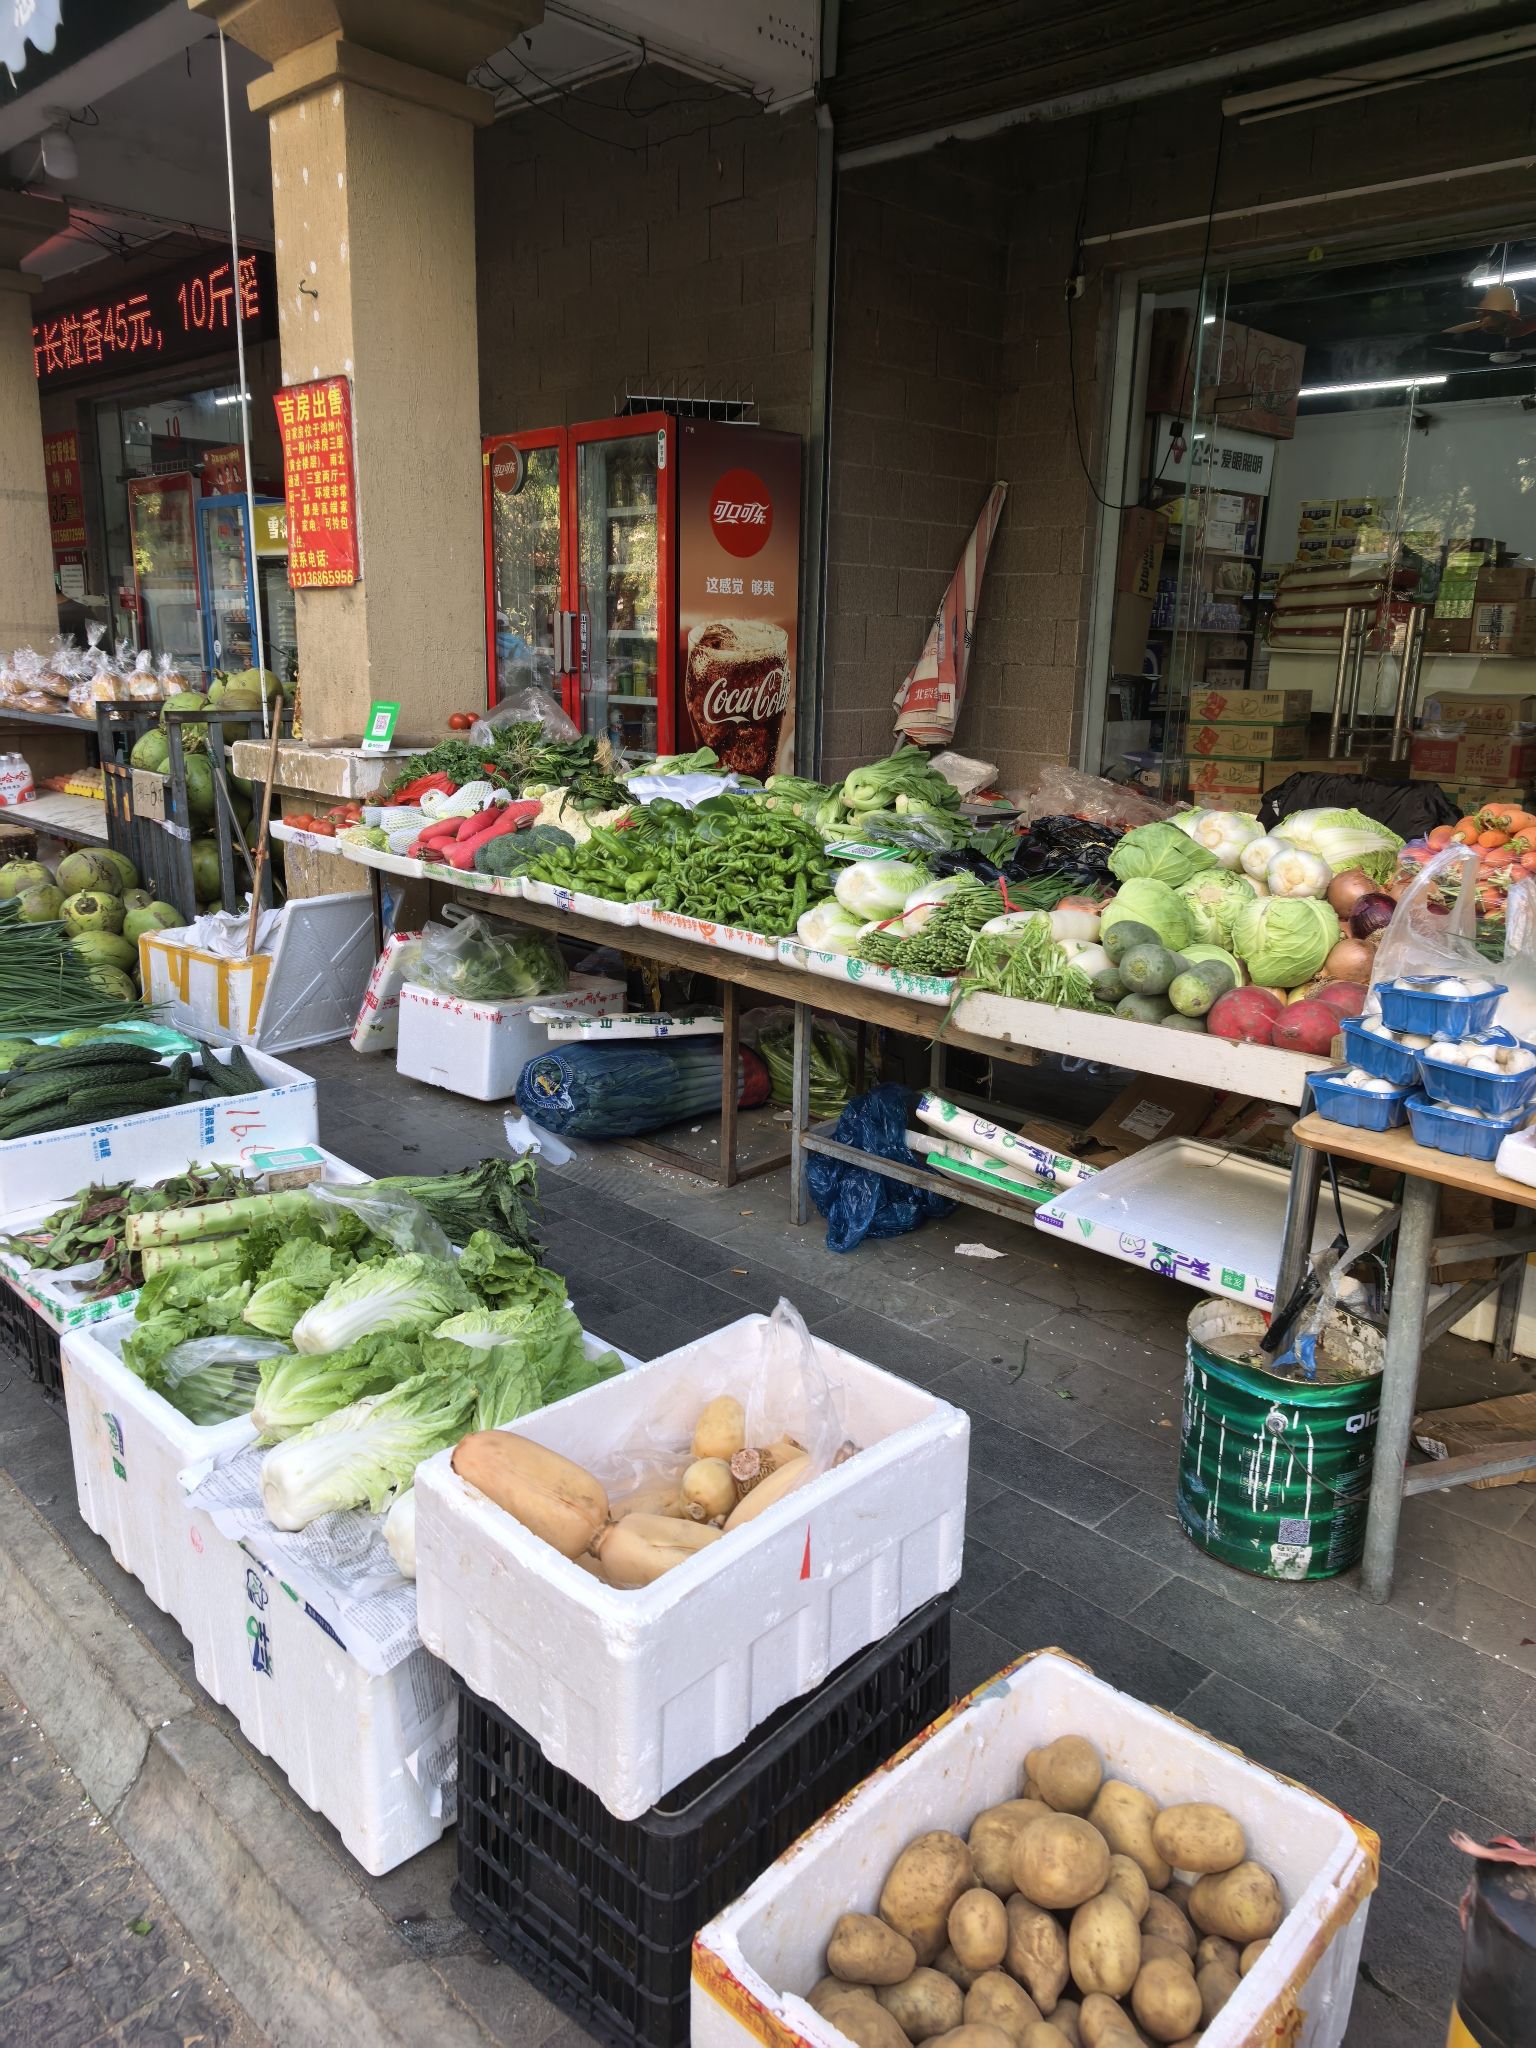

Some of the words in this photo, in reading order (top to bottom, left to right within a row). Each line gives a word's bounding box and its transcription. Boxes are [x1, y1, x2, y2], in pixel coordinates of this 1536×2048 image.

[278, 386, 342, 426] 吉房出售
[1221, 449, 1264, 475] 爱眼照明
[713, 500, 770, 525] 可口可乐
[706, 576, 744, 595] 这感觉
[750, 578, 776, 597] 够爽
